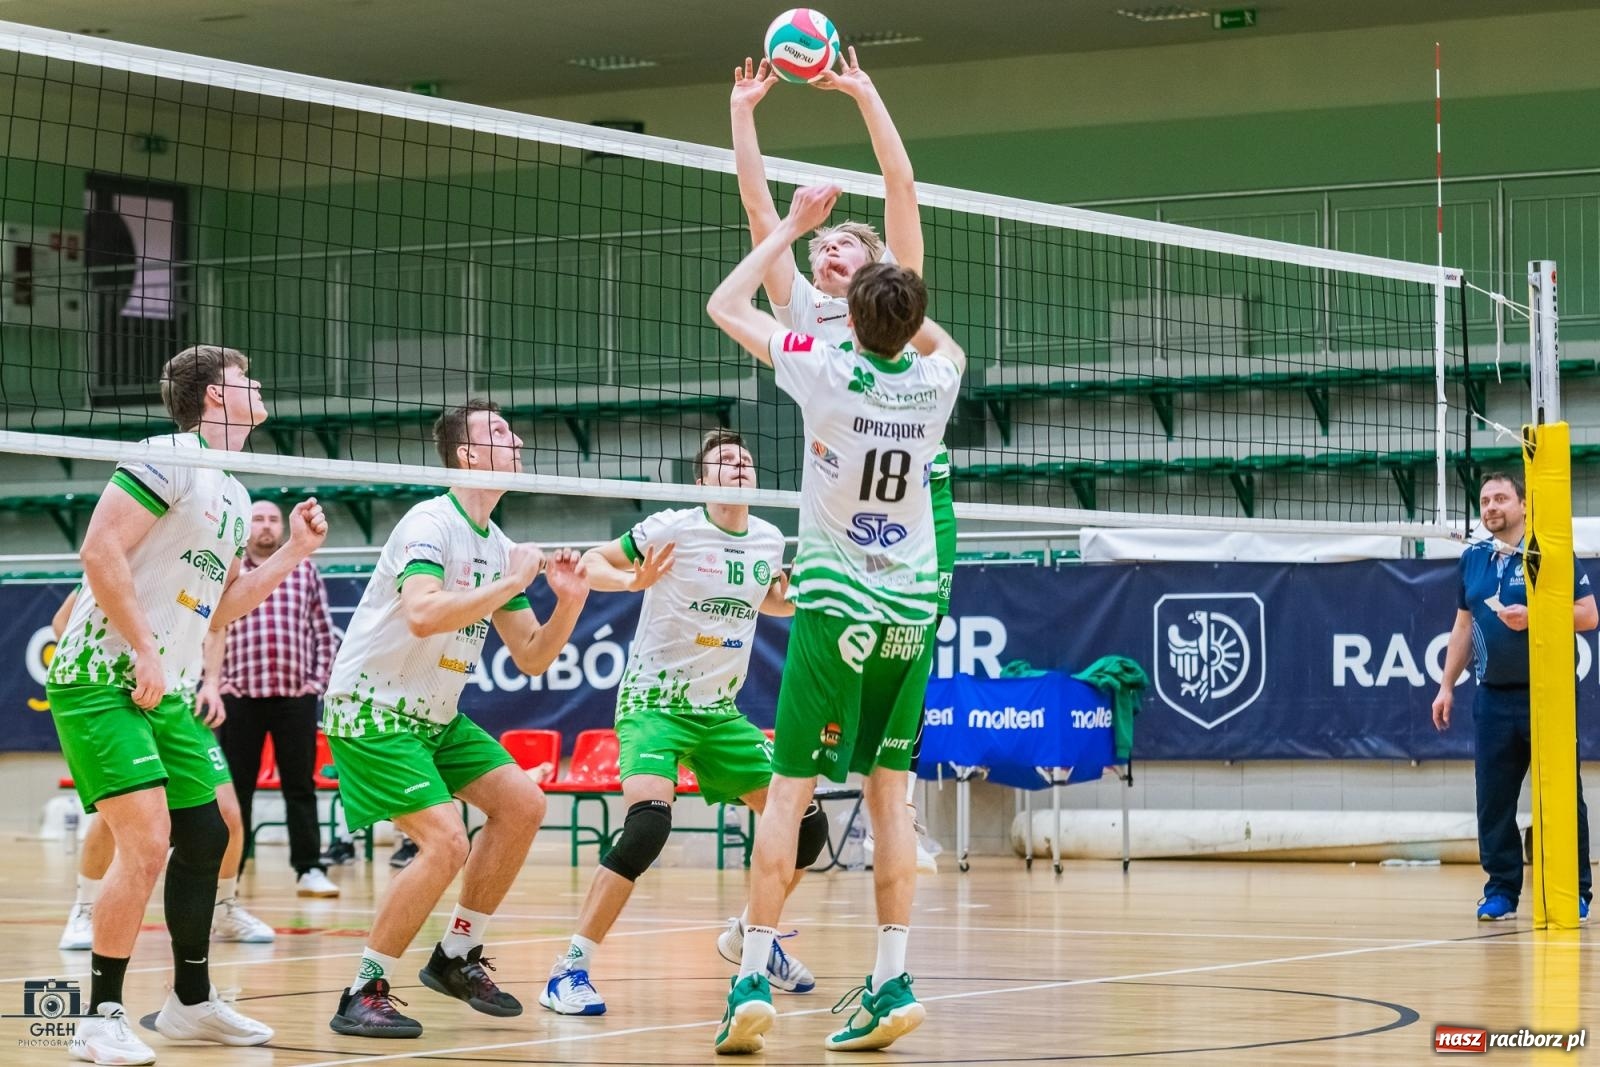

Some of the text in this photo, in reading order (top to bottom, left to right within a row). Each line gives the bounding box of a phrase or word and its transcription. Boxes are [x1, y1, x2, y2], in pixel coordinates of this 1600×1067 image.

[853, 416, 925, 441] OPRZĄDEK
[859, 448, 911, 503] 18
[725, 560, 744, 585] 16
[968, 707, 1045, 729] molten
